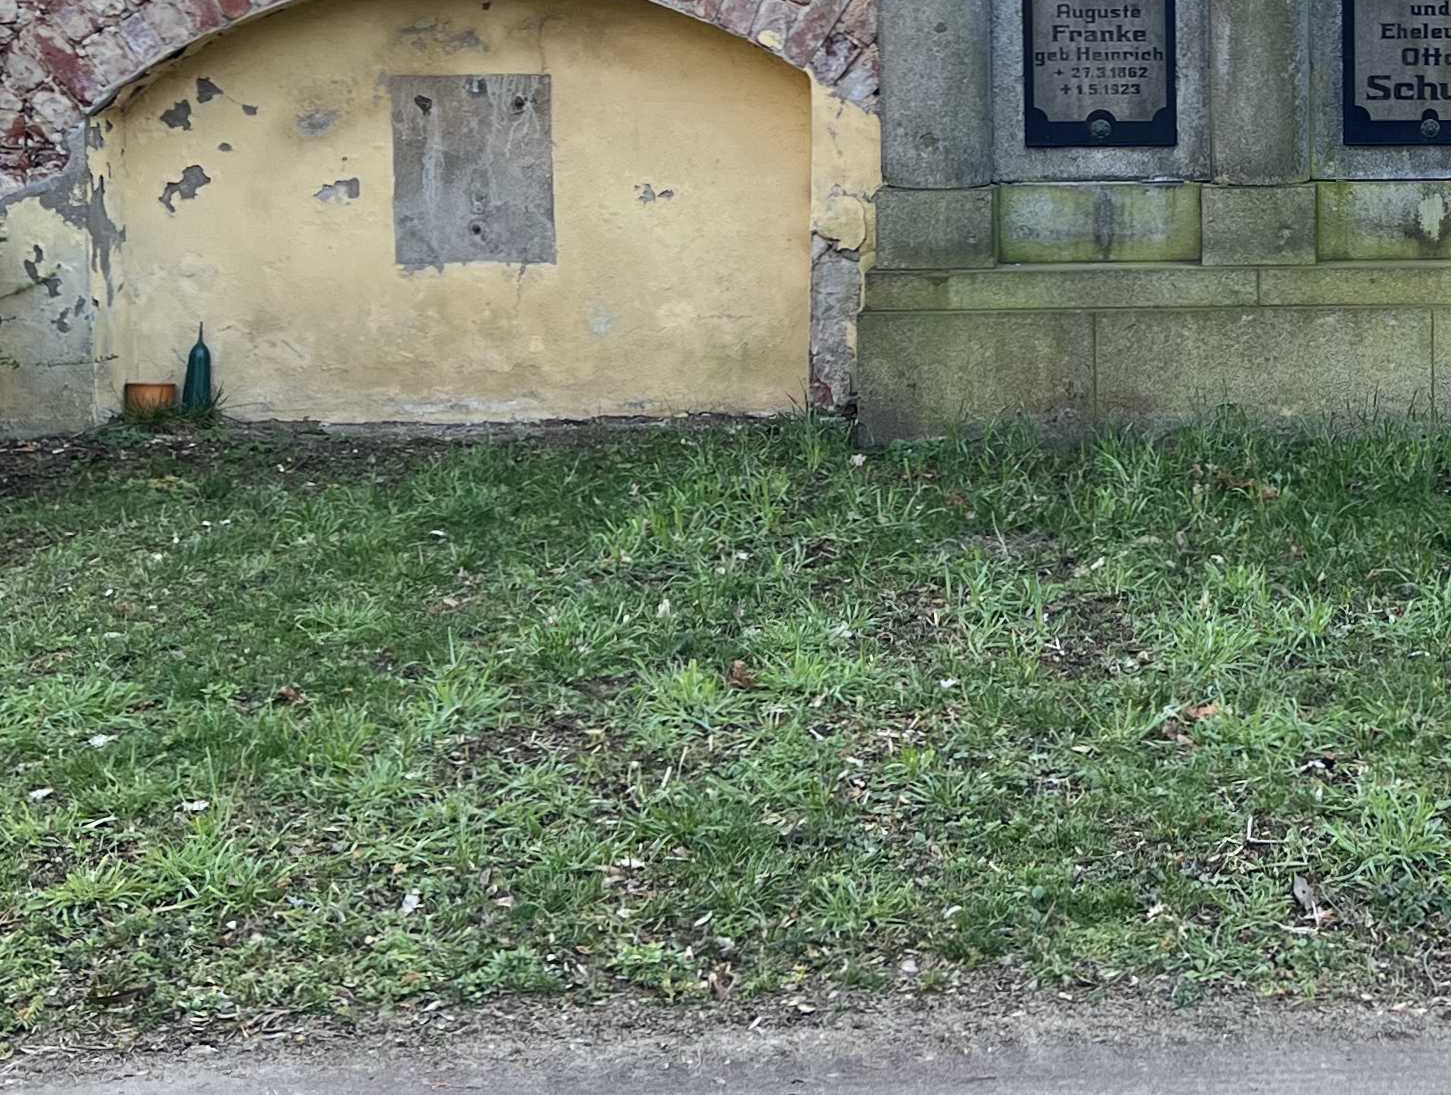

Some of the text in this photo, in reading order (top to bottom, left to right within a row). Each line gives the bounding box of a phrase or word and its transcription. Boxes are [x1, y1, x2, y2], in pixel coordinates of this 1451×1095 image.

[1055, 3, 1142, 24] Auguste
[1410, 0, 1451, 17] und
[1051, 24, 1147, 42] Franke
[1076, 46, 1164, 62] Heinrich
